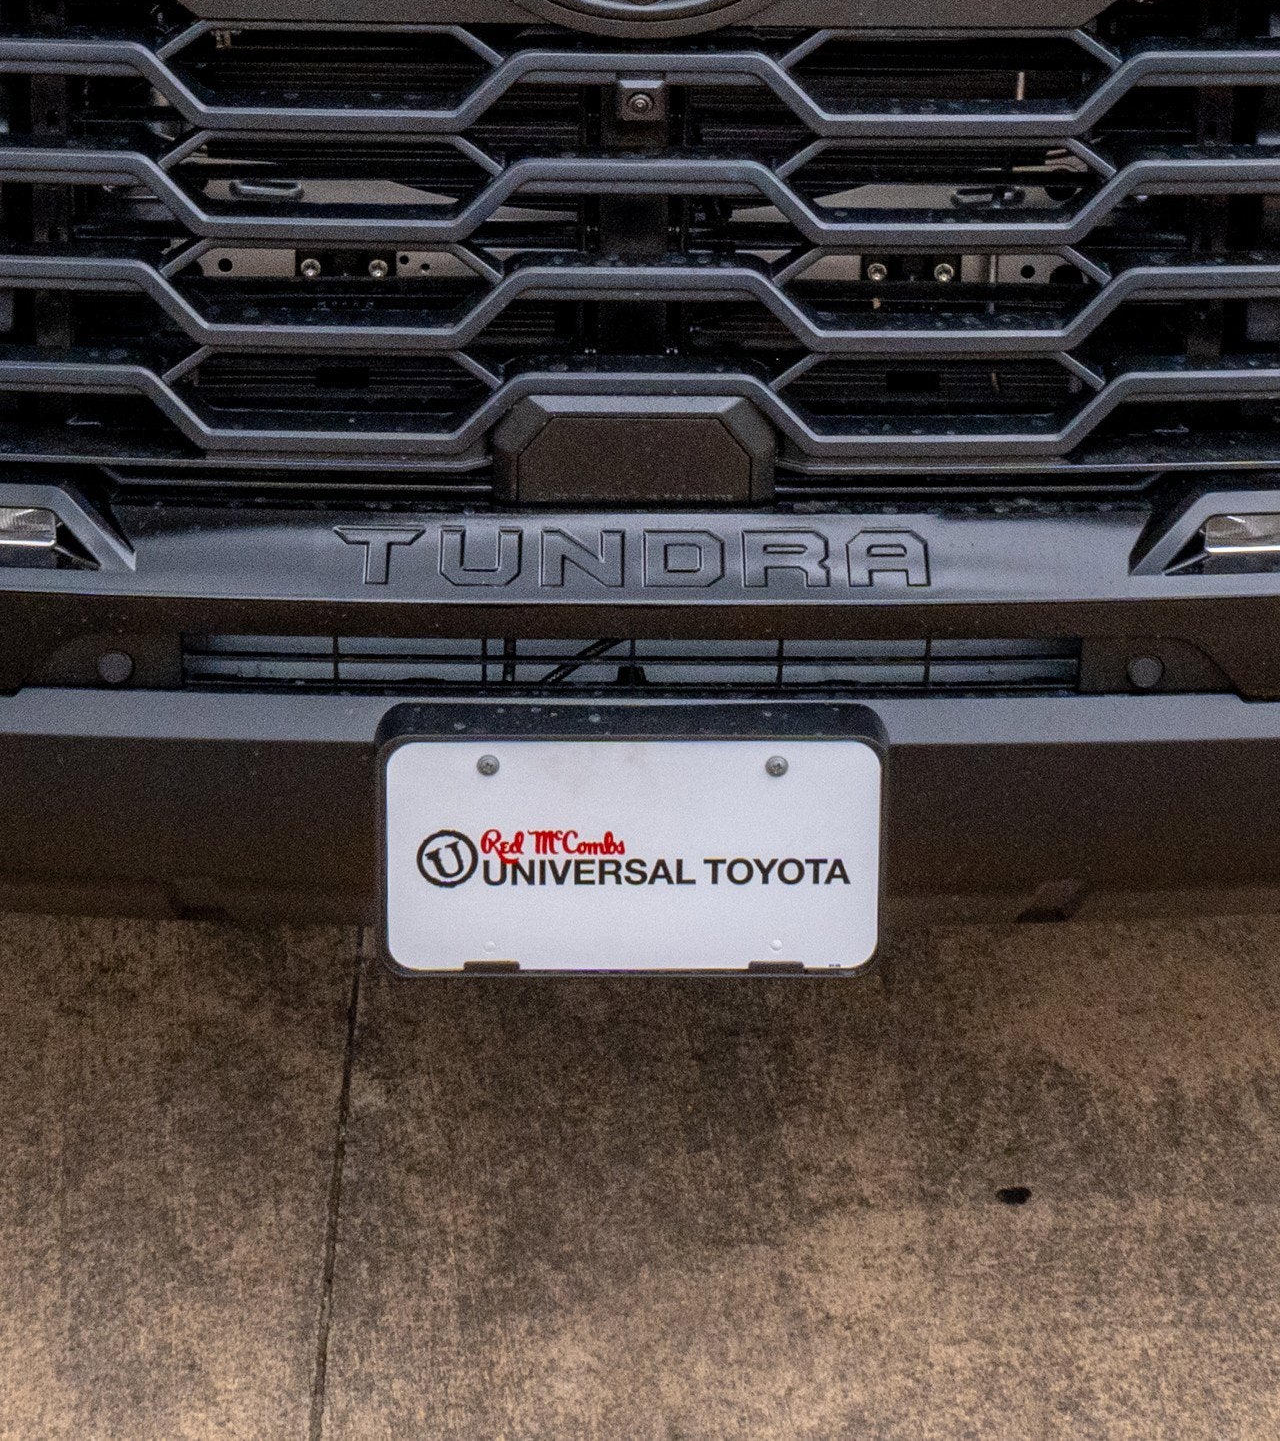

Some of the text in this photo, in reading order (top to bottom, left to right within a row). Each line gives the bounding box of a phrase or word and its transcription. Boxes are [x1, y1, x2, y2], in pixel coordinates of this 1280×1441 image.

[332, 525, 932, 588] TUNDRA
[480, 829, 625, 865] Red McCombs
[482, 859, 851, 886] UNIVERSAL TOYOTA
